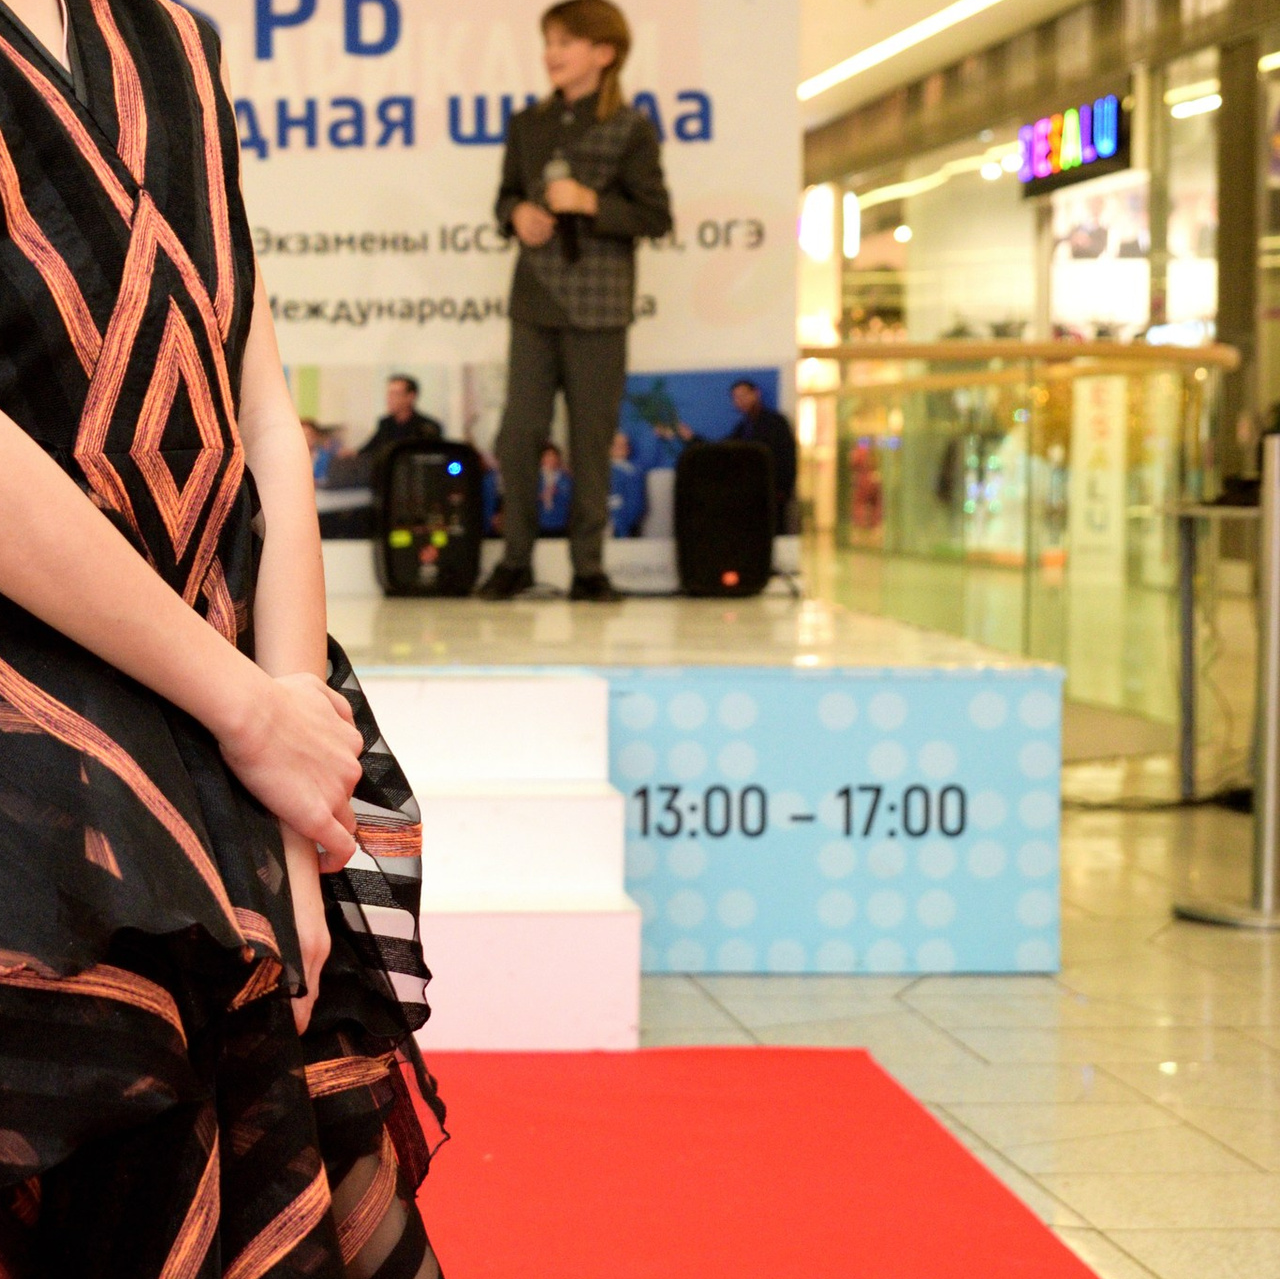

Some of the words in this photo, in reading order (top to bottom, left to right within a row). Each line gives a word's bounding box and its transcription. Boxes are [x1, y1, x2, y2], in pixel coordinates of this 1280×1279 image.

[233, 94, 416, 160] дная
[447, 89, 713, 147] шла
[253, 225, 429, 255] Экзамены
[438, 223, 512, 253] IGCS
[697, 218, 766, 250] ОГЭ
[268, 295, 508, 327] еждународн
[632, 783, 769, 840] 13:00
[836, 783, 969, 839] 17:00
